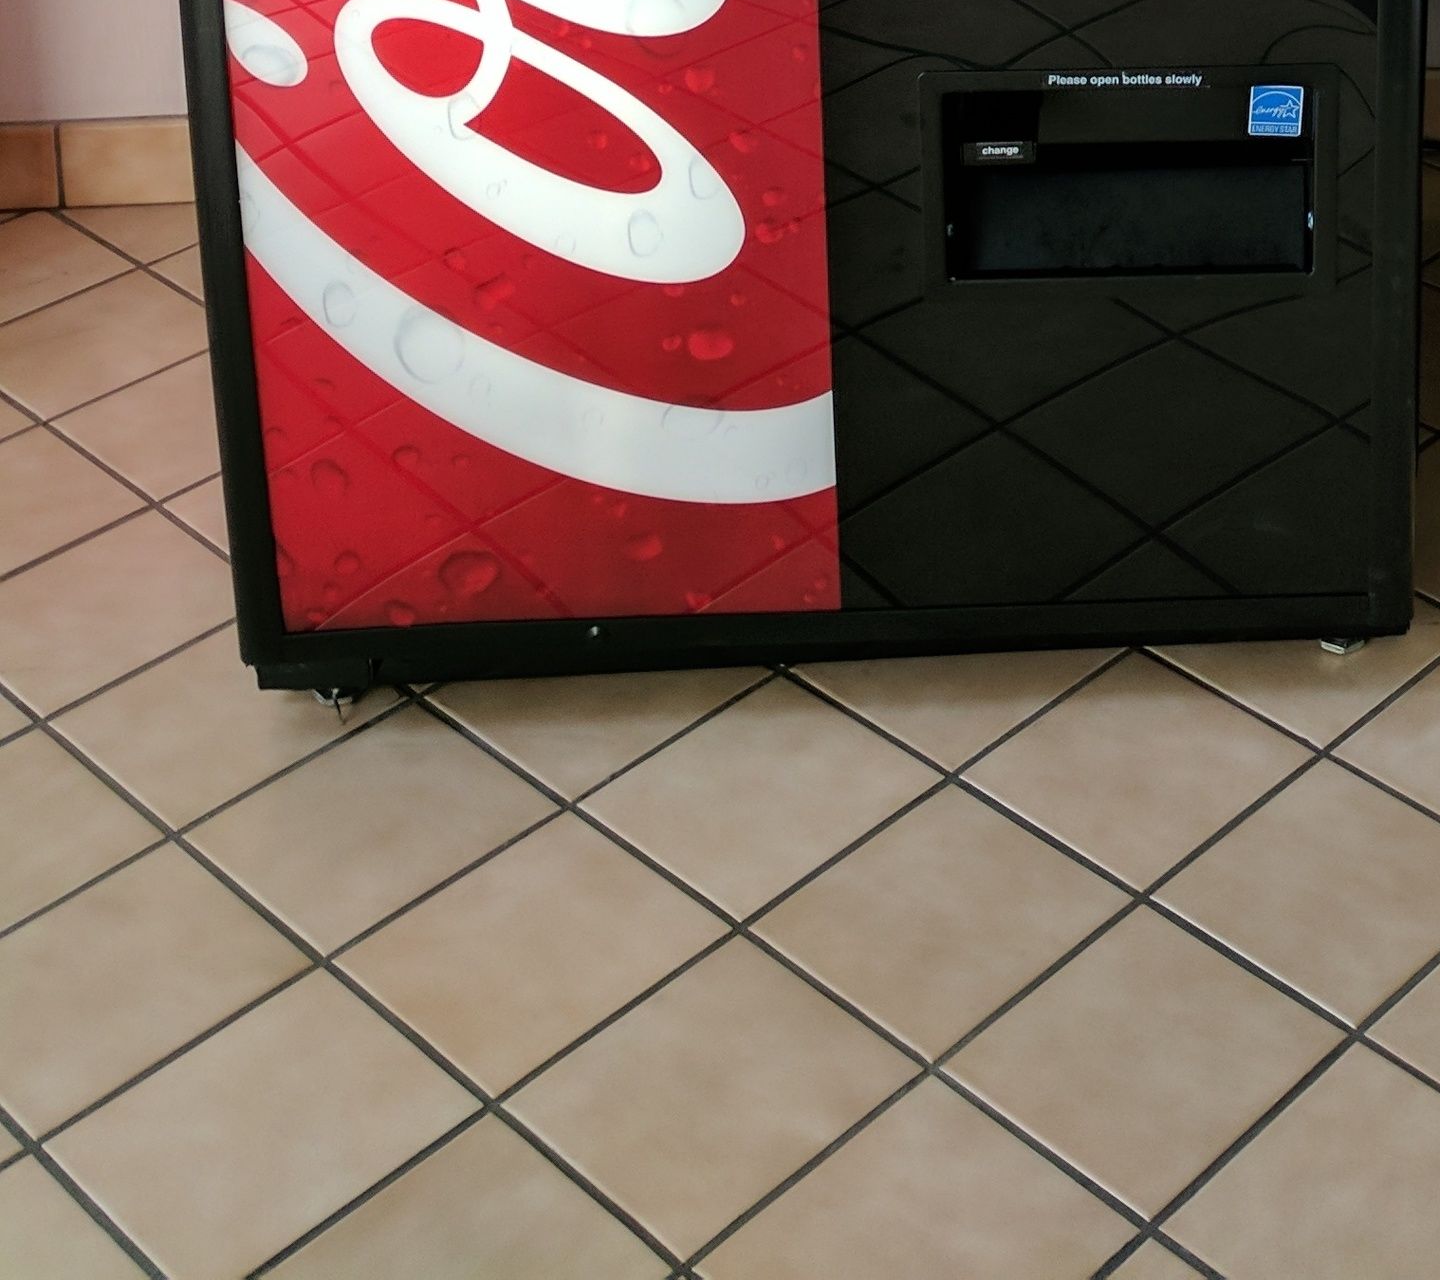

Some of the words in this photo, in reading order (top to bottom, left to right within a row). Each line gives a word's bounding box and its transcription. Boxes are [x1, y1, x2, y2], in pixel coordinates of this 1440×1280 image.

[1048, 74, 1088, 86] Please
[1090, 76, 1120, 86] open
[1122, 73, 1163, 85] bottles
[1165, 74, 1202, 86] slowly
[1251, 125, 1278, 134] ENERGY
[1279, 125, 1298, 134] STAR
[982, 144, 1019, 157] change
